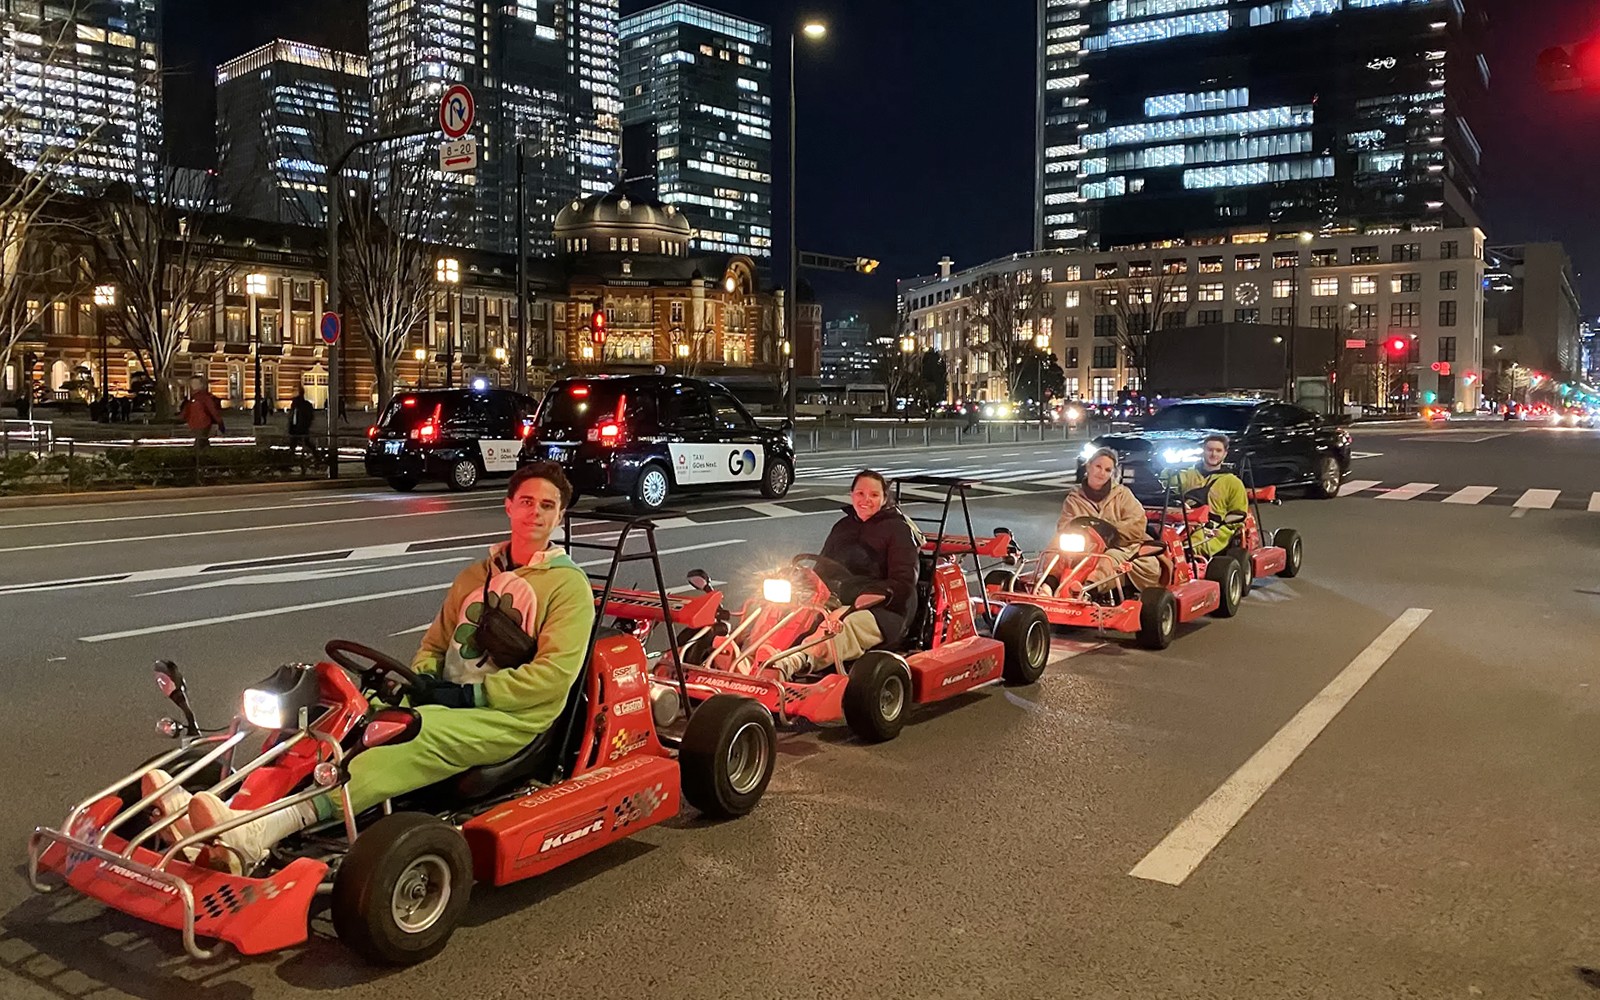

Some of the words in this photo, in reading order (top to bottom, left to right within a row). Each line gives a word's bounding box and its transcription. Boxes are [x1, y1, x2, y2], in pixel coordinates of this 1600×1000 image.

[446, 143, 471, 156] 8-20
[728, 449, 756, 476] GO
[695, 675, 769, 695] STANDARDMOTO
[941, 670, 971, 687] Kart
[540, 819, 605, 853] Kart
